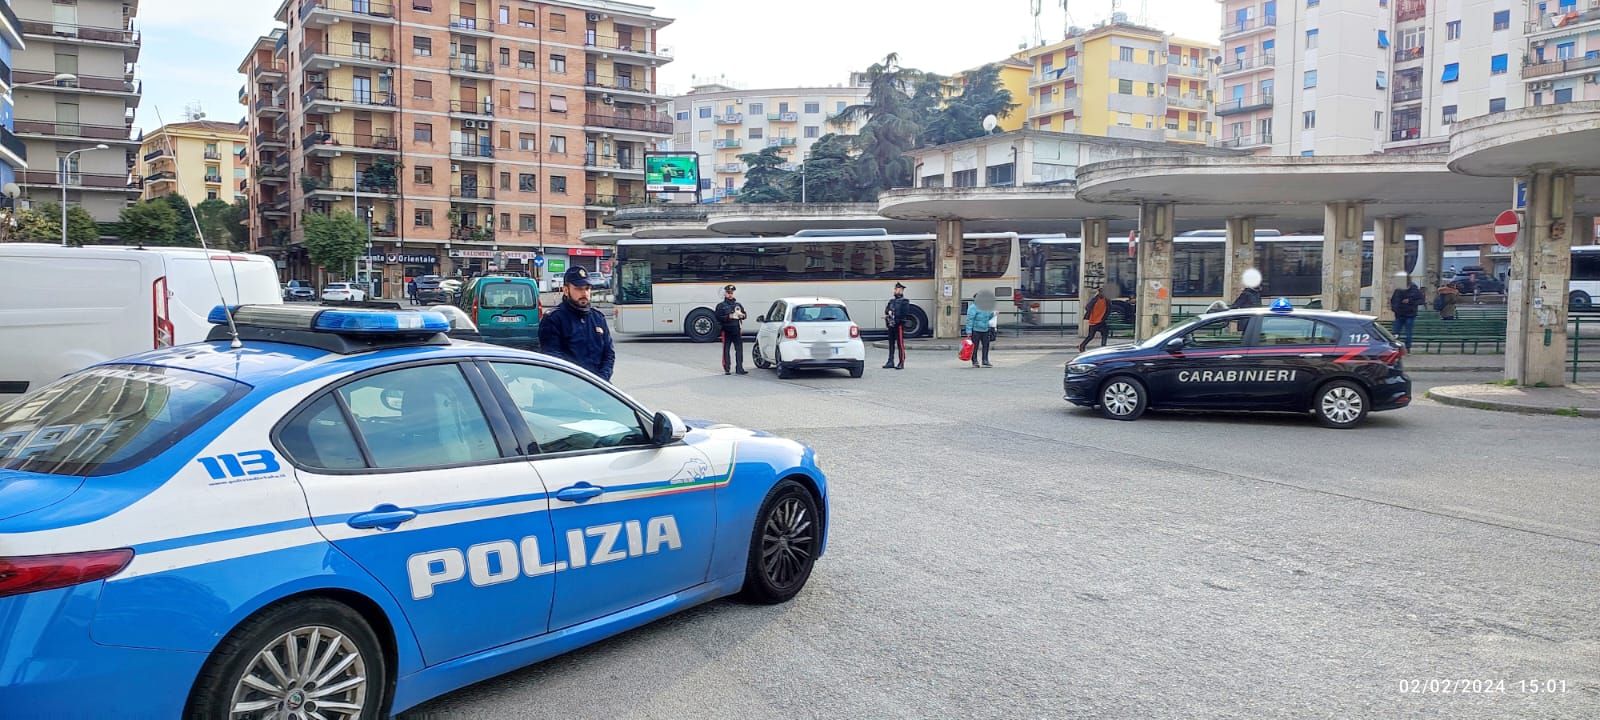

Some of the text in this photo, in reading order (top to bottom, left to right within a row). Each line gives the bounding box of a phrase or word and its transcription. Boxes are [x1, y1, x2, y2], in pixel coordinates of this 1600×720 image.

[398, 255, 436, 263] Orientale
[1349, 334, 1370, 343] 112
[1178, 370, 1296, 382] CARABINIERI
[197, 449, 281, 480] 113
[407, 514, 682, 600] POLIZIA
